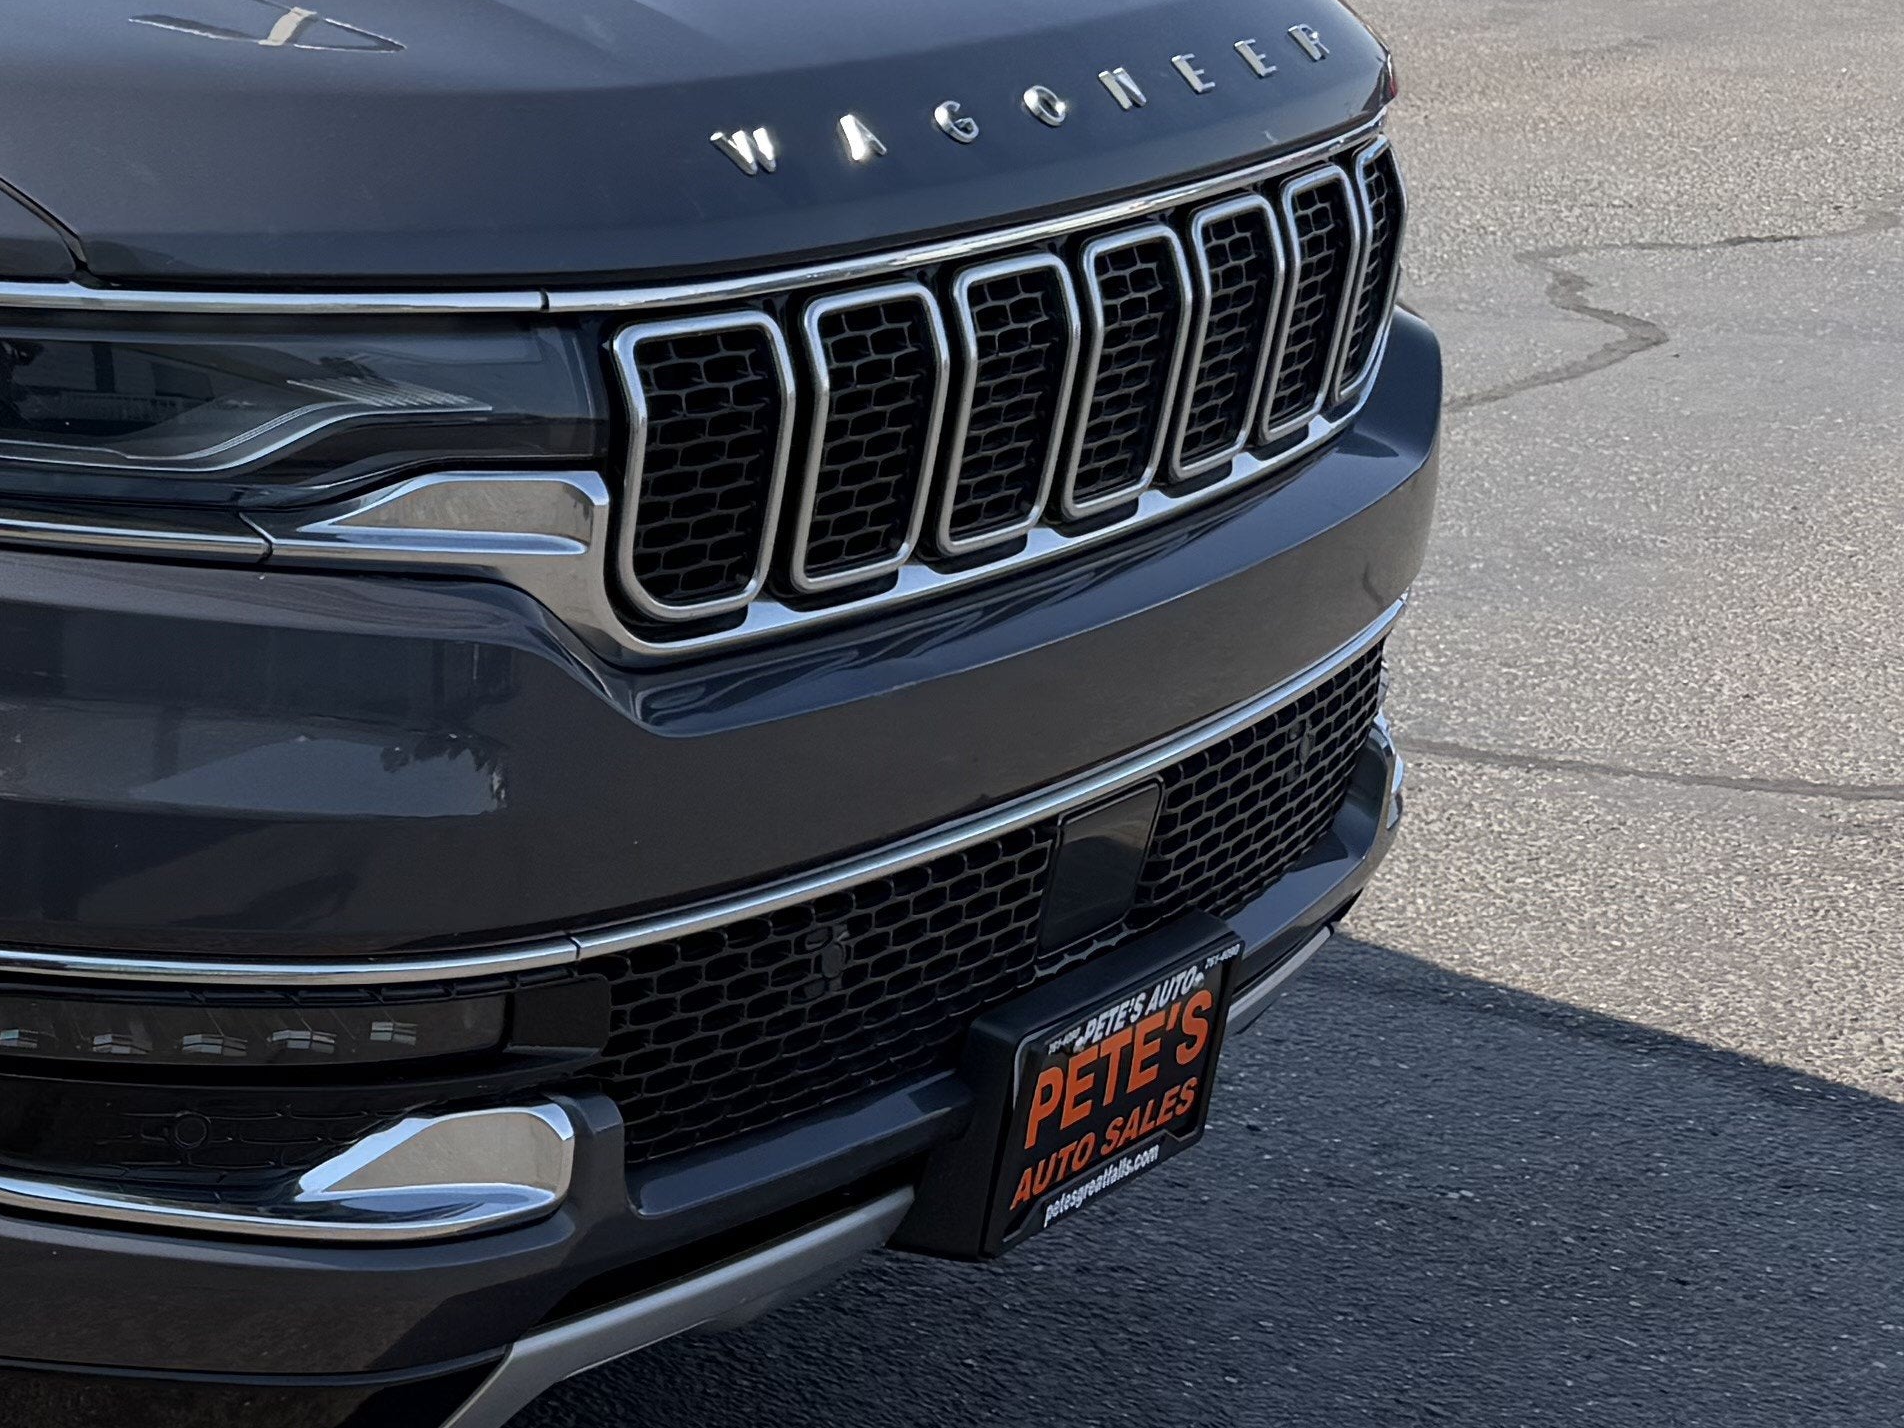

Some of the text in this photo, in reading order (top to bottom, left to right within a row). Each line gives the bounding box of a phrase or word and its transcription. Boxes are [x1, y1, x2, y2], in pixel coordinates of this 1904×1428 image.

[709, 23, 1331, 175] WAGONEER
[1144, 966, 1198, 1016] AUTO
[1024, 989, 1213, 1150] PETE'S
[1010, 1076, 1198, 1211] AUTO SALES
